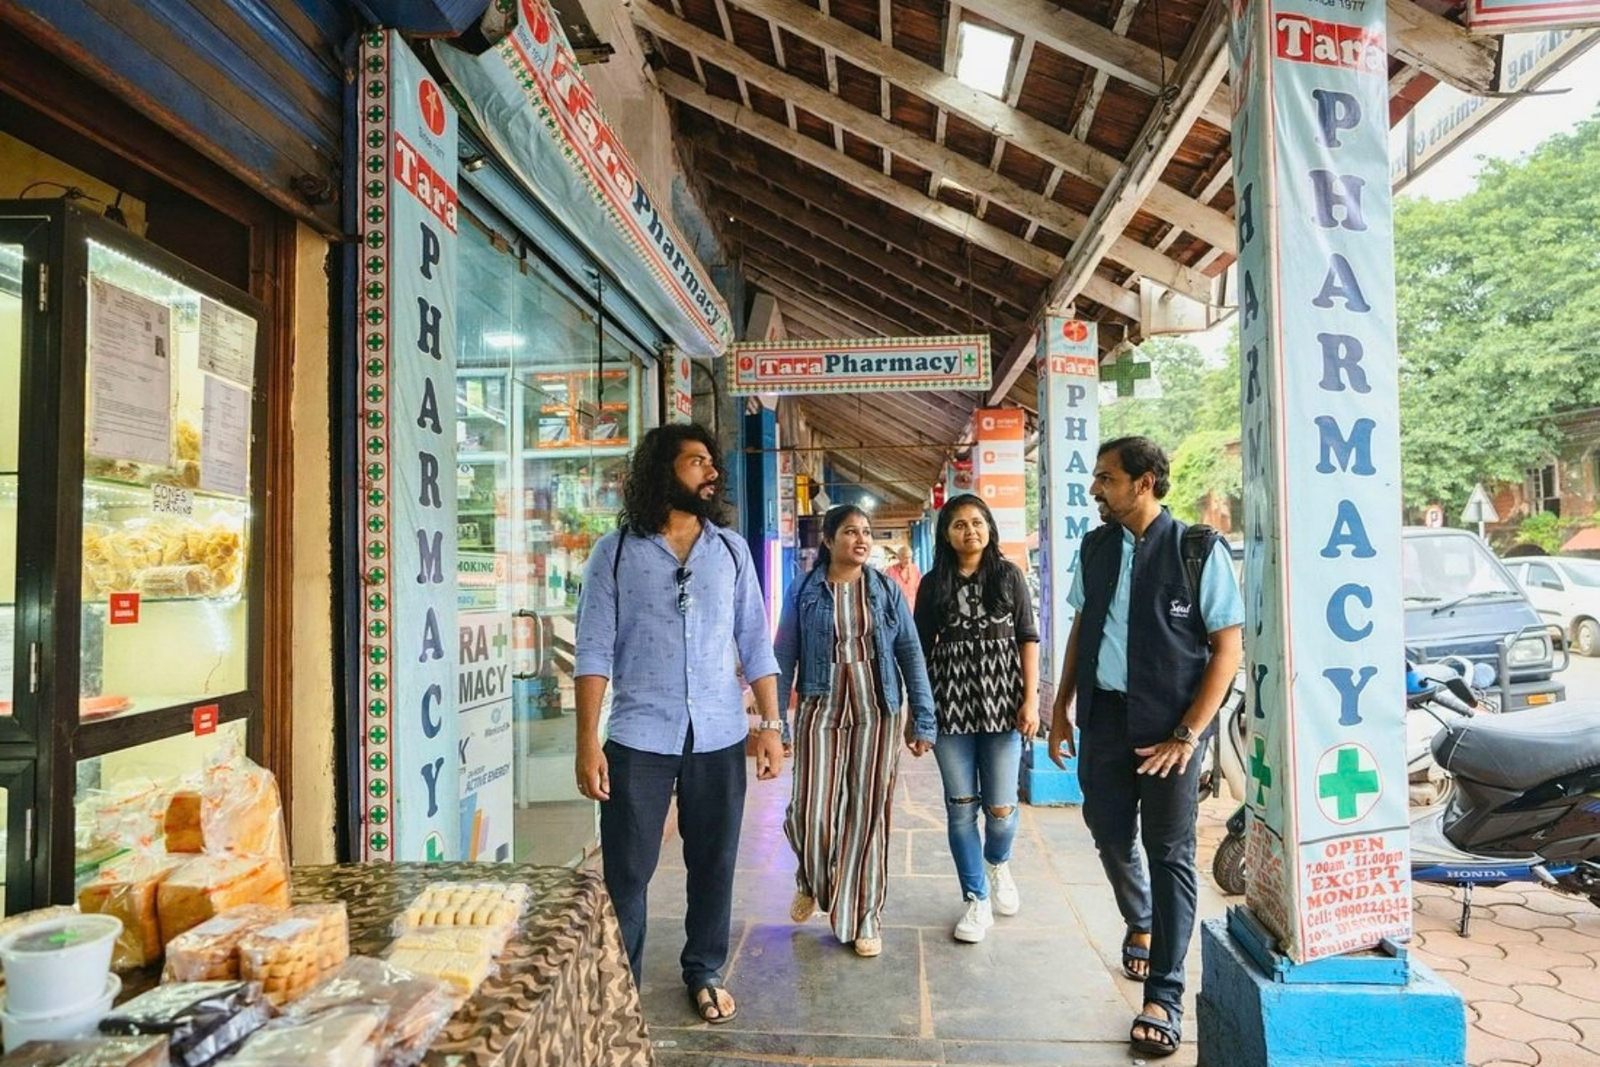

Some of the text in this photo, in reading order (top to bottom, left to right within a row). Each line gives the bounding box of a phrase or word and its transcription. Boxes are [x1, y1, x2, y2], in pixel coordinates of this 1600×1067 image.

[1278, 18, 1386, 70] Tara
[552, 50, 633, 200] Tara
[396, 139, 457, 232] Tara
[632, 180, 721, 326] Pharmacy
[761, 354, 958, 375] Tara Pharmacy
[1052, 357, 1096, 376] Tara
[1309, 88, 1378, 726] PHARMACY
[154, 484, 187, 502] CONES
[1065, 384, 1090, 574] PHARM
[416, 221, 445, 819] PHARMACY
[459, 625, 489, 665] RA
[459, 664, 508, 704] MACY
[1325, 837, 1385, 858] OPEN
[1306, 860, 1345, 878] 7.00am
[1355, 852, 1403, 867] 11.00pm
[1311, 865, 1400, 892] EXCEPT
[1447, 870, 1508, 879] HONDA
[1306, 880, 1406, 910] MONDAY
[1307, 911, 1332, 928] Cell:
[1308, 911, 1410, 944] 10% DISCOUNT
[1309, 937, 1356, 958] Senior
